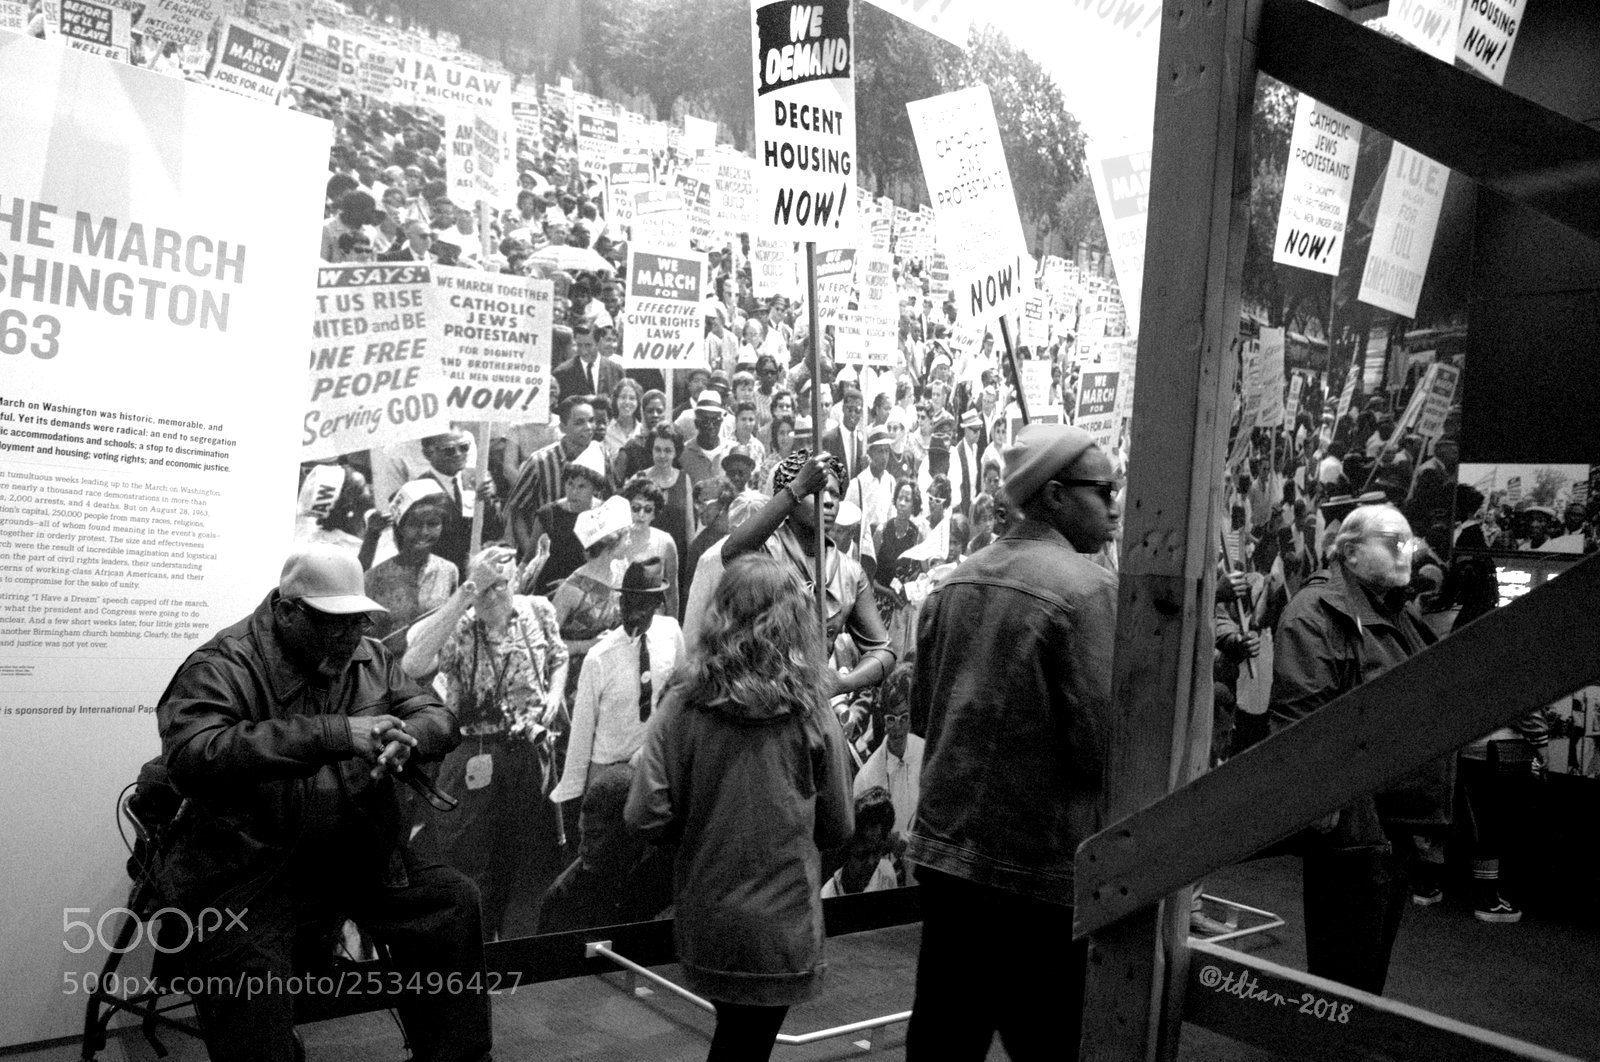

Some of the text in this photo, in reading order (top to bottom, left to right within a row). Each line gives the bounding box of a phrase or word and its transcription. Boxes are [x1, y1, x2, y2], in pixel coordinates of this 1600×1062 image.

[64, 1, 109, 20] BEFORE
[171, 14, 192, 24] FOR
[1470, 0, 1516, 38] HOUSING
[62, 23, 70, 33] A
[145, 17, 203, 39] INTEGRATED
[790, 5, 823, 42] WE
[104, 50, 120, 60] BE
[252, 37, 271, 53] WE
[1464, 26, 1508, 70] NOW!
[229, 42, 282, 72] MARCH
[242, 62, 262, 74] FOR
[765, 38, 848, 86] DEMAND
[214, 70, 238, 85] JOBS
[239, 77, 258, 91] FOR
[258, 83, 274, 97] ALL
[446, 69, 501, 94] UAW
[774, 99, 842, 136] DECENT
[1308, 111, 1350, 140] CATHOLIC
[1314, 134, 1338, 156] JEWS
[764, 140, 851, 176] HOUSING
[1296, 148, 1350, 180] PROTESTANTS
[774, 182, 847, 229] NOW!
[72, 210, 246, 284] MARCH
[1284, 228, 1336, 264] NOW!
[348, 266, 426, 285] SAYS:
[657, 258, 678, 272] WE
[436, 276, 549, 302] WE MARCH TOGETHER
[637, 270, 696, 290] MARCH
[970, 256, 1020, 316] NOW!
[336, 292, 364, 313] US
[372, 290, 423, 310] RISE
[655, 288, 678, 298] FOR
[450, 295, 536, 318] CATHOLIC
[636, 302, 696, 316] EFFECTIVE
[372, 314, 400, 333] and
[402, 312, 426, 330] BE
[466, 312, 518, 328] JEWS
[628, 314, 700, 329] CIVIL RIGHTS
[444, 324, 538, 346] PROTESTANT
[646, 328, 680, 340] LAWS
[362, 338, 427, 366] FREE
[459, 346, 525, 358] FOR DIGNITY
[632, 342, 694, 360] NOW!
[450, 370, 543, 386] ALL MEN UNDER GOD
[468, 360, 540, 374] BROTHERHOOD
[310, 366, 420, 402] PEOPLE
[1094, 375, 1108, 388] WE
[446, 386, 540, 412] NOW!
[1081, 388, 1115, 405] MARCH
[42, 402, 97, 416] Washington
[100, 411, 117, 419] was
[119, 411, 154, 424] historic,
[158, 418, 205, 430] memorable,
[302, 392, 438, 447] Serving GOD
[1090, 404, 1104, 413] FOR
[18, 413, 34, 423] Yet
[36, 415, 48, 425] its
[50, 417, 91, 430] demands
[93, 424, 114, 433] were
[116, 426, 148, 436] radical:
[180, 433, 188, 441] to
[190, 435, 236, 446] segregation
[1102, 420, 1112, 430] ALL
[10, 429, 84, 443] accommodations
[86, 437, 102, 445] and
[104, 438, 137, 449] schools;
[146, 443, 163, 453] stop
[166, 445, 173, 453] to
[175, 446, 229, 459] discrimination
[36, 446, 53, 454] and
[55, 446, 91, 460] housing;
[93, 452, 119, 463] voting
[120, 454, 147, 464] rights;
[149, 457, 164, 465] and
[165, 460, 202, 469] economic
[203, 463, 231, 473] justice.
[36, 566, 92, 576] working-class
[94, 568, 124, 577] African
[126, 570, 169, 579] Americans,
[3, 706, 13, 715] is
[15, 705, 64, 716] sponsored
[66, 705, 77, 715] by
[79, 705, 136, 714] International
